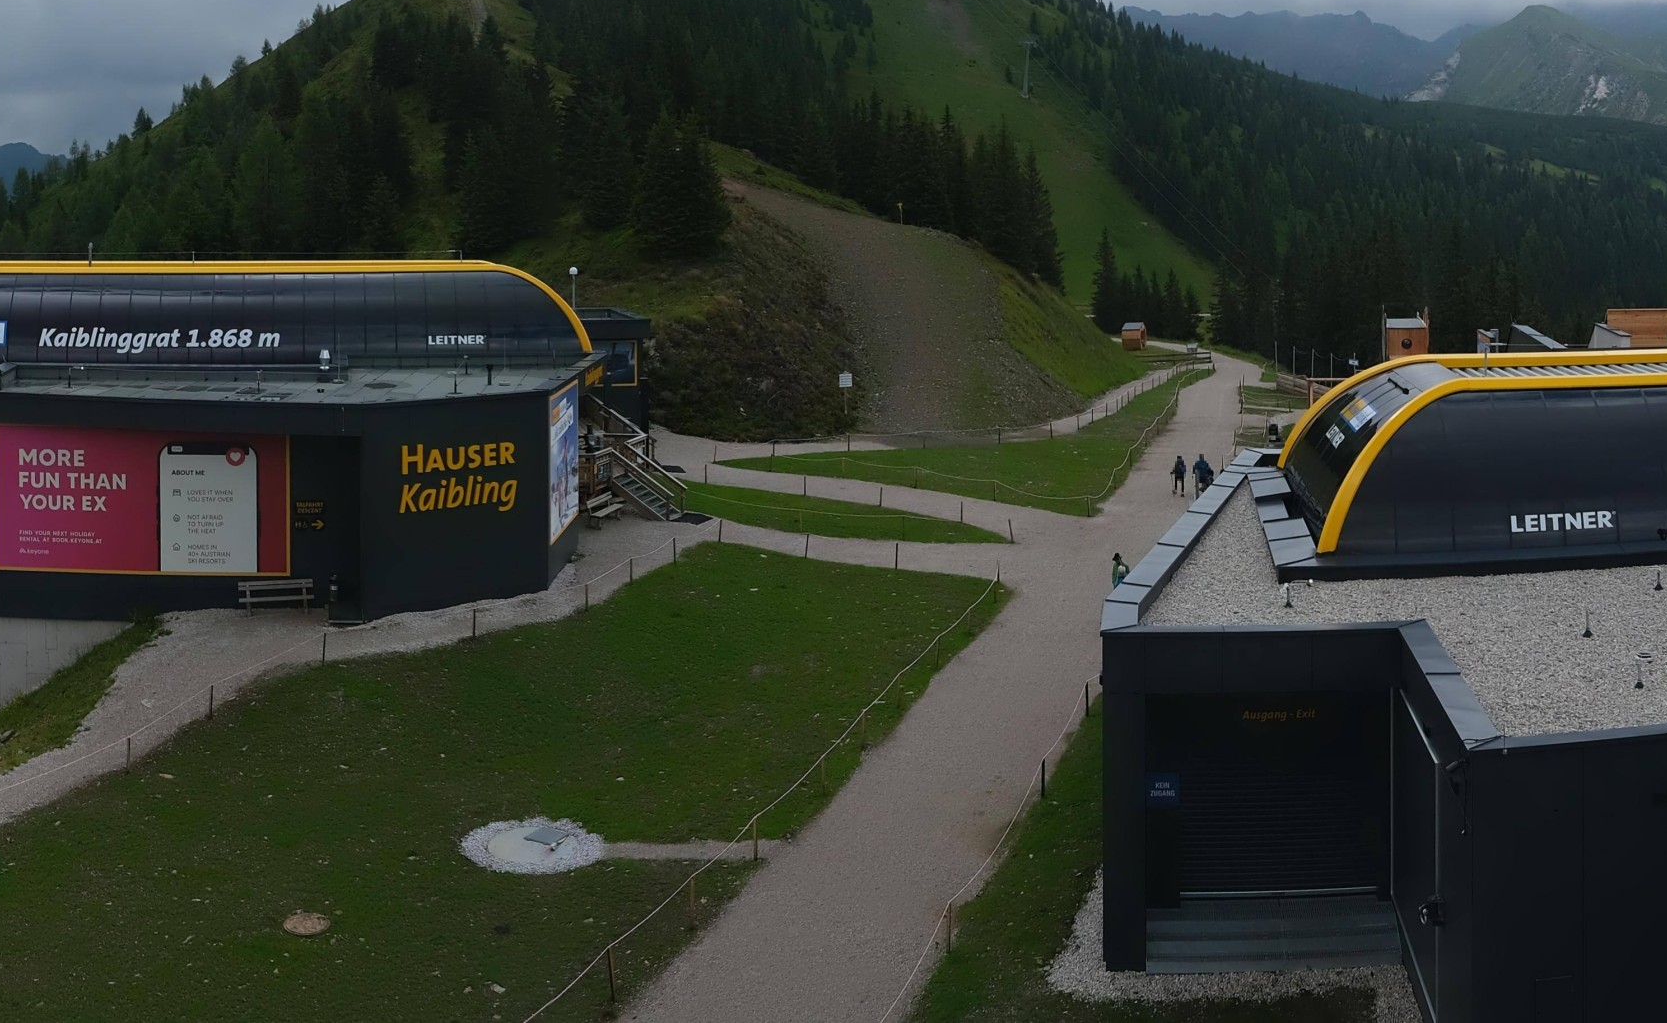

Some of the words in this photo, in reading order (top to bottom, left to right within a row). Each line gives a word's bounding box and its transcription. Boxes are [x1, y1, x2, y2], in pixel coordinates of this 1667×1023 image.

[38, 327, 180, 354] Kaiblinggrat
[186, 328, 252, 348] 1.868
[258, 332, 281, 348] m
[427, 334, 486, 346] LEITNER
[18, 448, 85, 467] MORE
[401, 441, 516, 475] HAUSER
[18, 471, 60, 489] FUN
[67, 472, 127, 490] THAN
[20, 493, 75, 511] YOUR
[81, 495, 107, 512] EX
[399, 475, 518, 512] Kaibling
[1510, 510, 1614, 533] LEITNER
[1242, 710, 1288, 722] Ausgang
[1296, 708, 1317, 719] Exit
[1149, 789, 1176, 797] ZUGANG
[1155, 781, 1170, 789] KEIN
